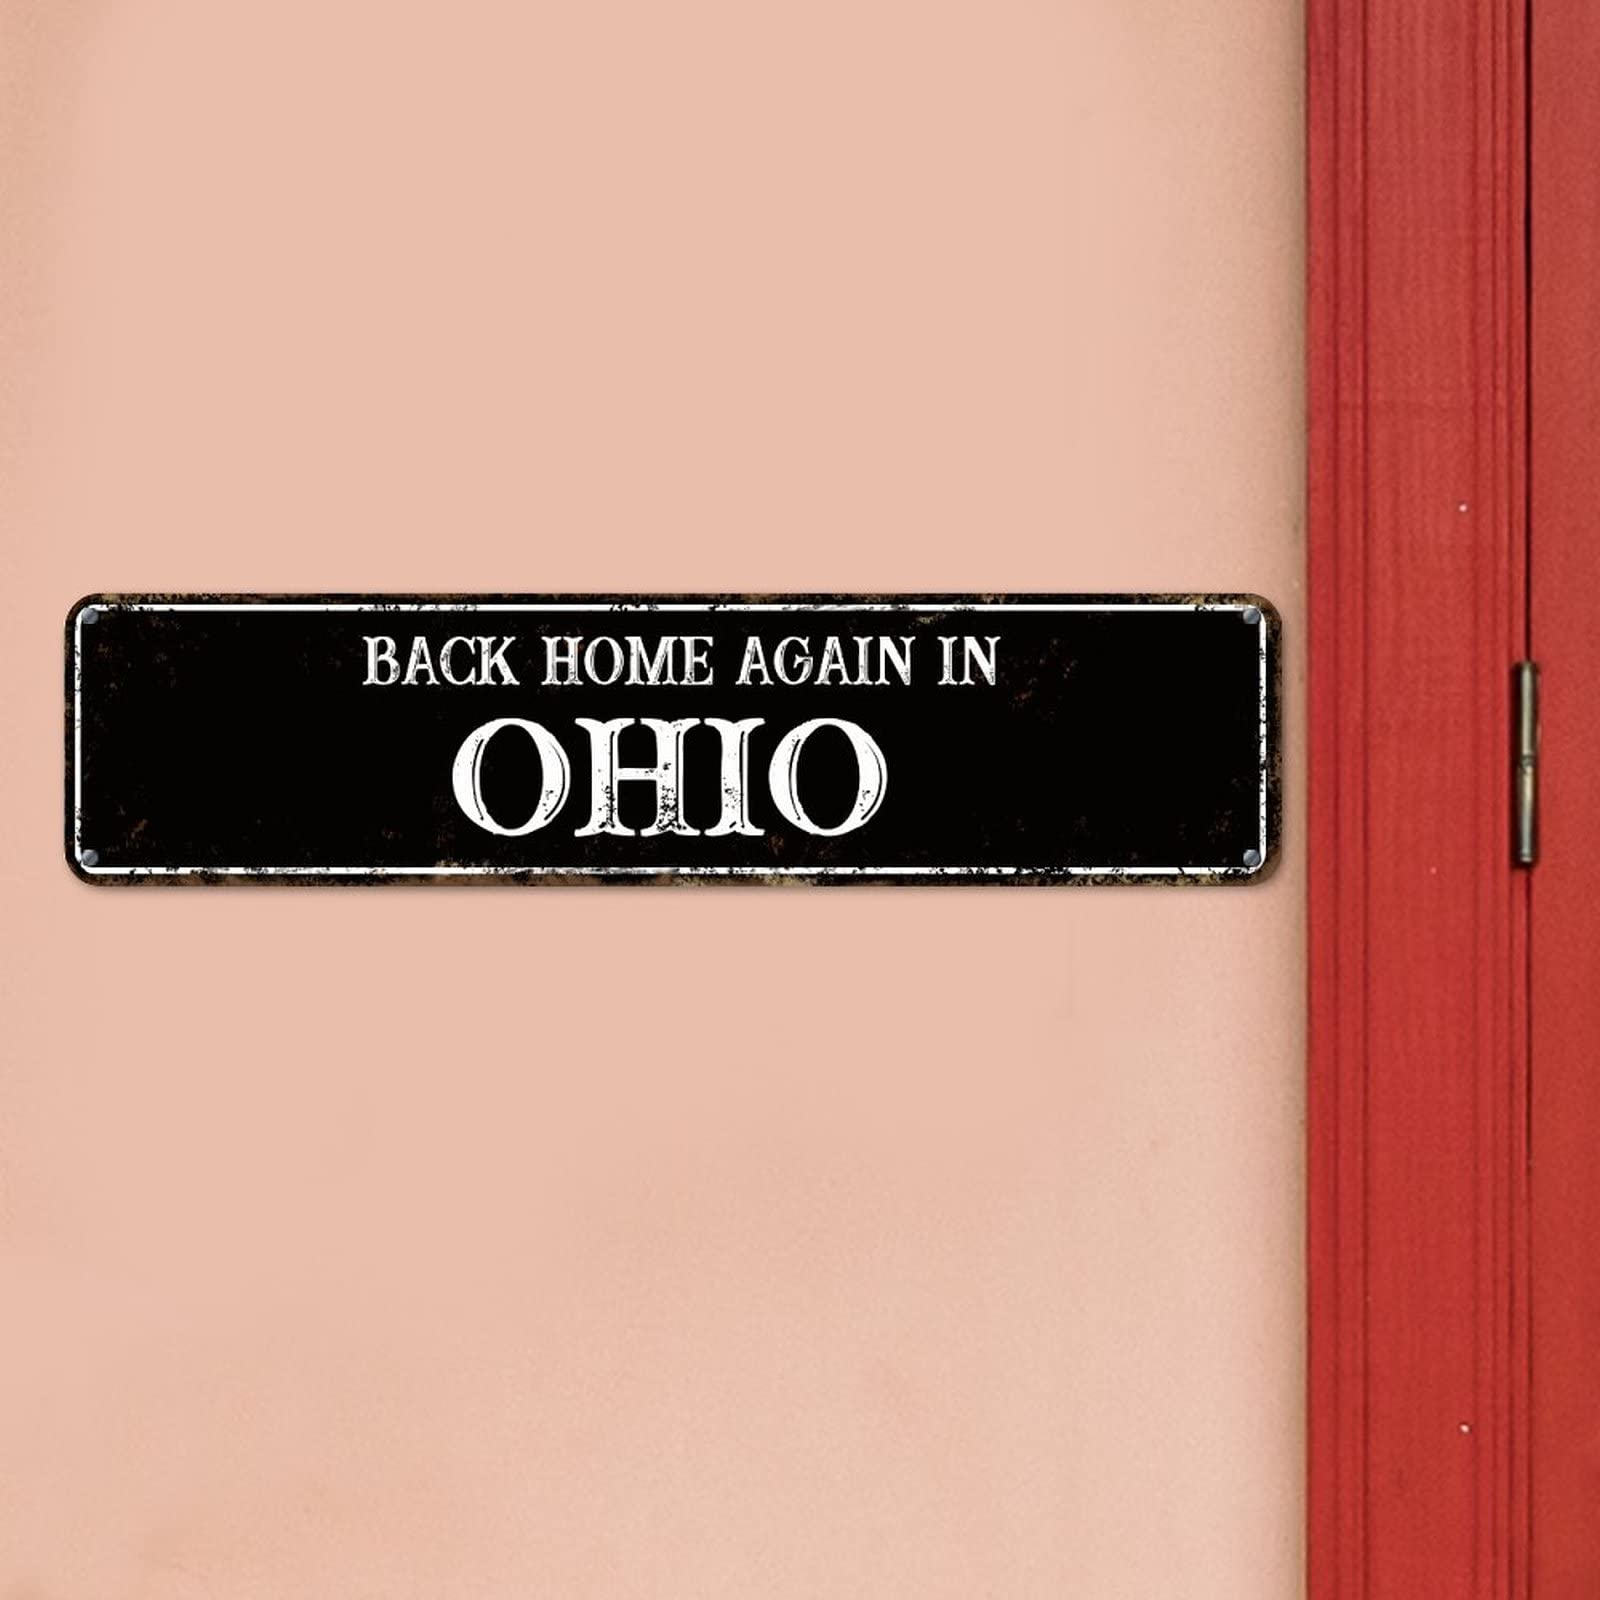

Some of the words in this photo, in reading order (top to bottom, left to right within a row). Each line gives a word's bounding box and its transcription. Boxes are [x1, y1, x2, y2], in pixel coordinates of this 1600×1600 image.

[362, 635, 521, 686] BACK
[541, 635, 714, 686] HOME
[735, 635, 916, 686] AGAIN
[937, 635, 1001, 686] IN
[451, 717, 888, 838] OHIO
